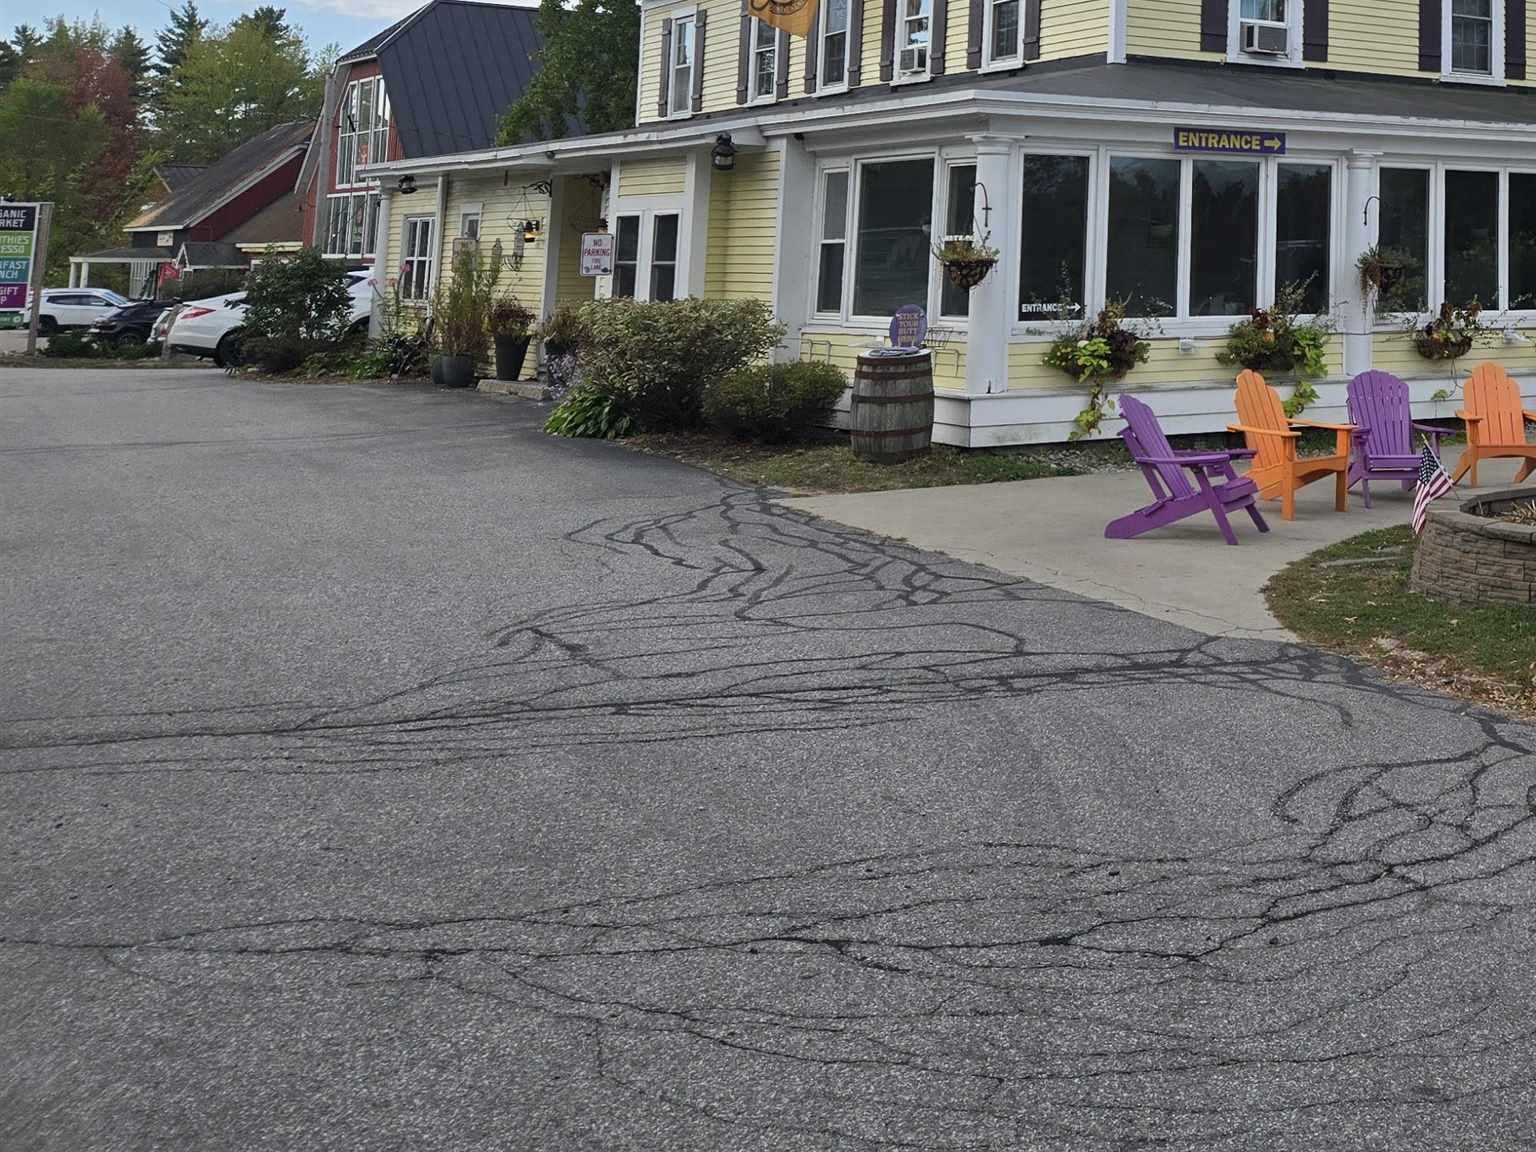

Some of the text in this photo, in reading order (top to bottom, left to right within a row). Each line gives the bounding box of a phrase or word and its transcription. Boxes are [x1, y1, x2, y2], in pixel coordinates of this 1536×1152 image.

[1179, 132, 1261, 149] ENTRANCE
[0, 235, 30, 244] THIES
[1021, 303, 1063, 313] ENTRANCE
